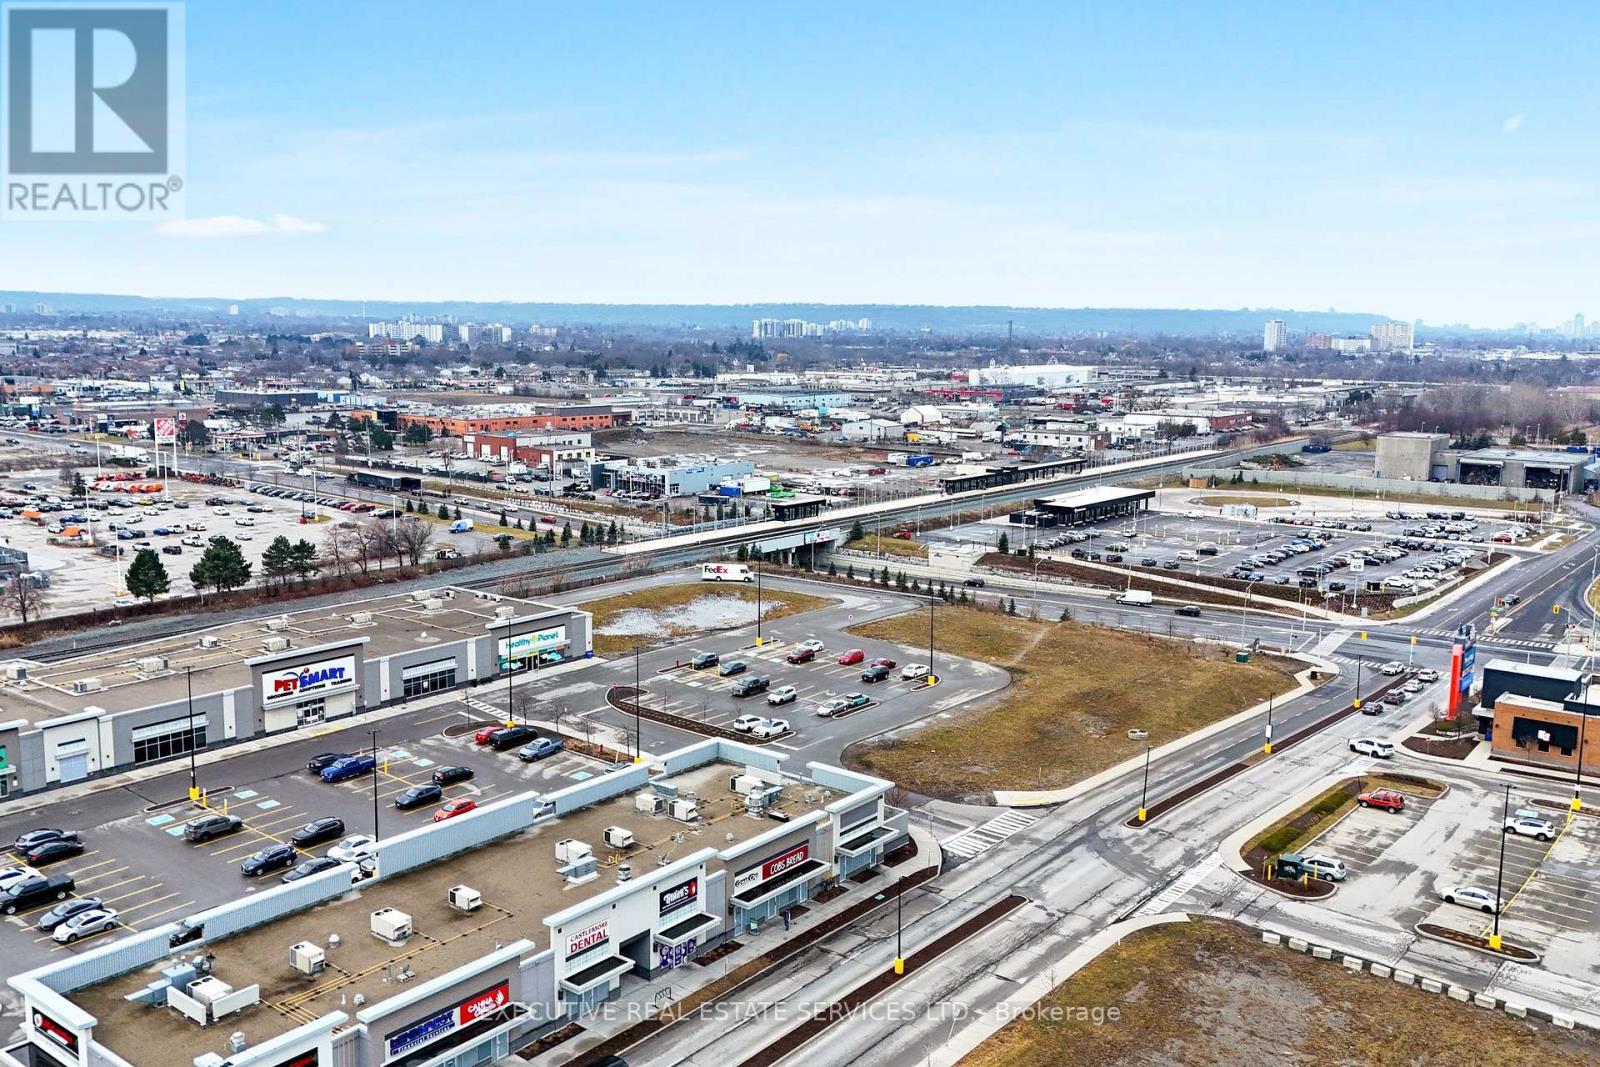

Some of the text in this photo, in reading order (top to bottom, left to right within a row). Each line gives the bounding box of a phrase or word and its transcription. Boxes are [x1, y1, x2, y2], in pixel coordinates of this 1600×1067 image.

[704, 565, 728, 574] FedEx
[770, 851, 804, 875] COBS BREAD
[570, 920, 608, 942] CASTLEMORE
[570, 928, 608, 953] DENTAL
